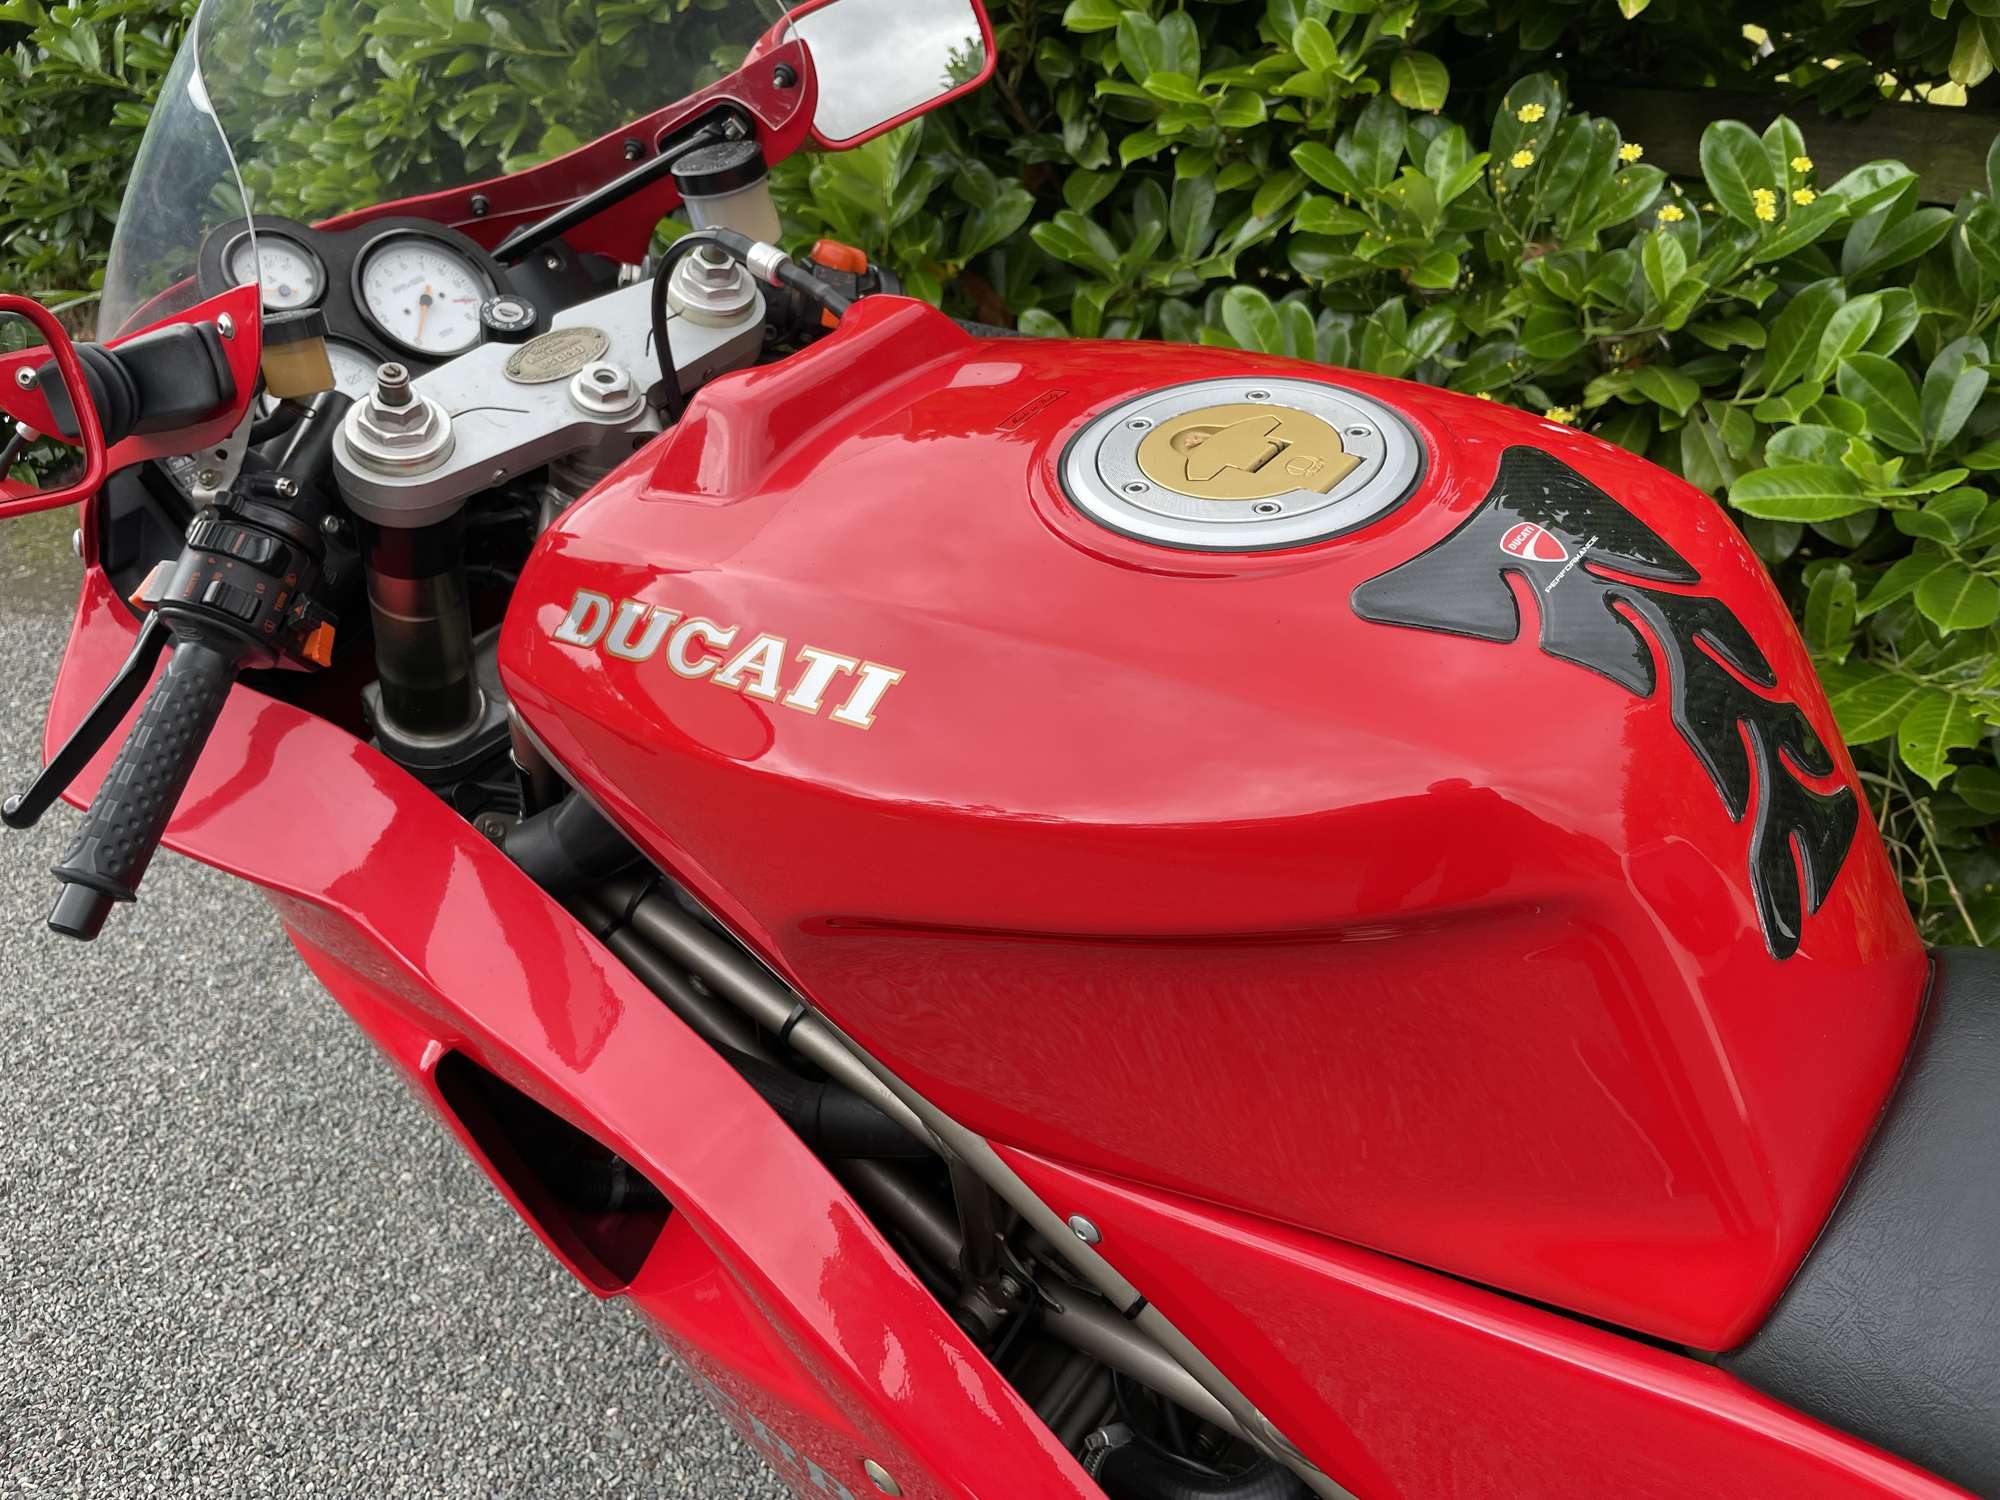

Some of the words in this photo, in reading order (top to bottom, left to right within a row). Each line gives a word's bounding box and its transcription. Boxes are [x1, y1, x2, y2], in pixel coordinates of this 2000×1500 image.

[1508, 526, 1535, 550] DUCATI
[1545, 535, 1599, 593] PERFORMANCE
[553, 588, 907, 731] DUCATI
